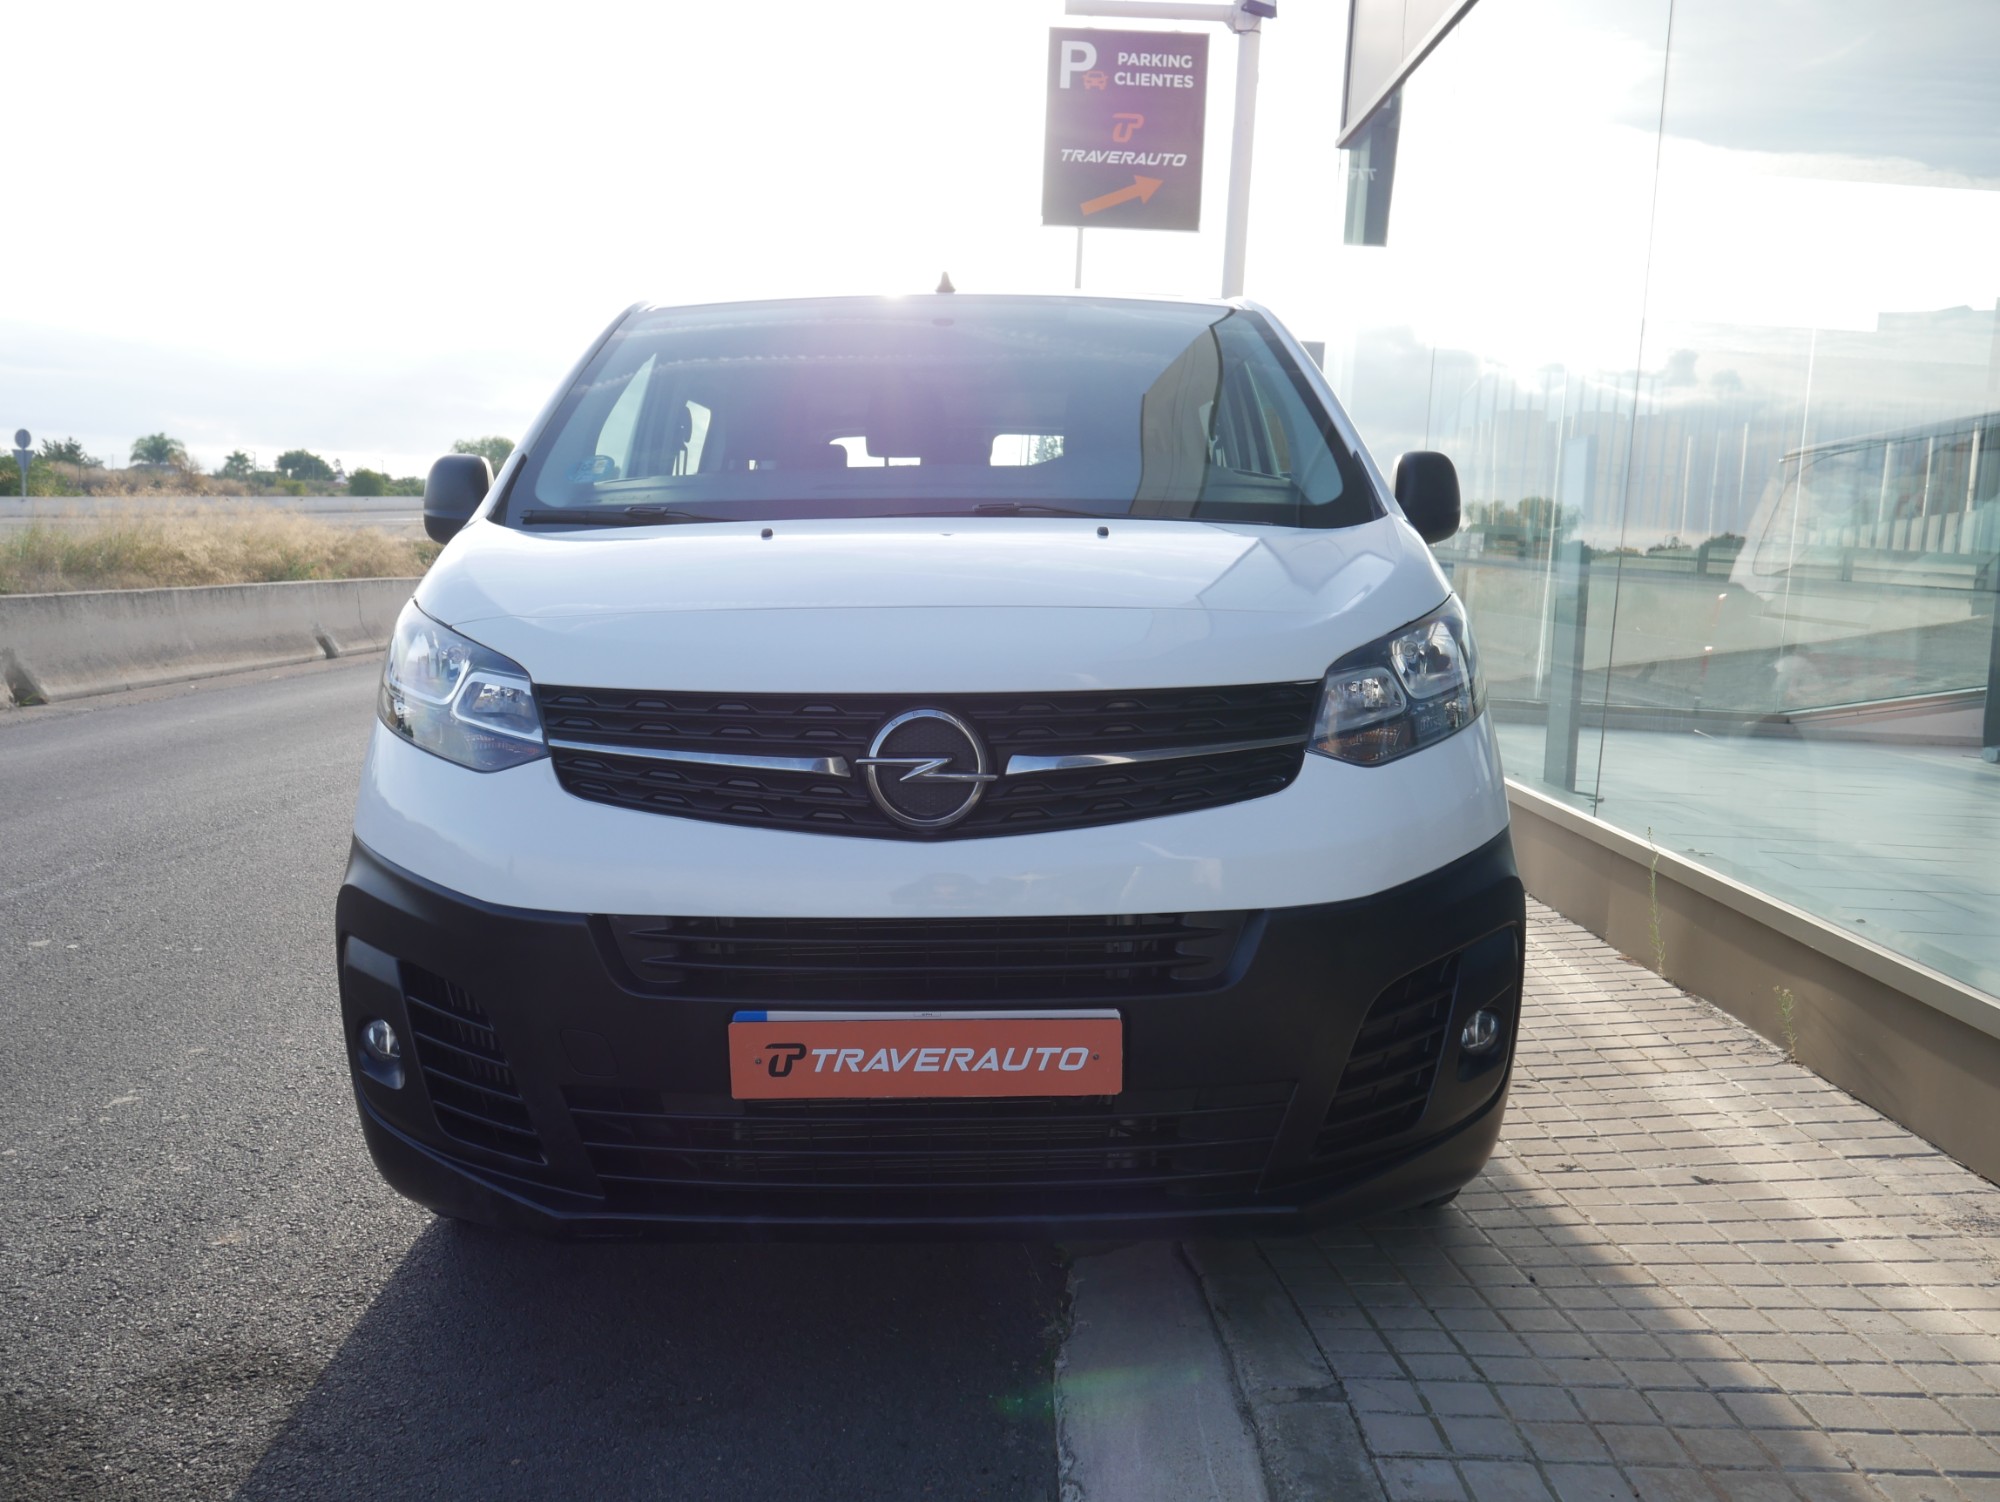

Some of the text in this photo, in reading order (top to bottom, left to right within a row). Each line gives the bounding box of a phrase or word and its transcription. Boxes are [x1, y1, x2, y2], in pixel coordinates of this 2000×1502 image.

[1059, 40, 1097, 89] P
[1117, 52, 1193, 69] PARKING
[1114, 72, 1194, 88] CLIENTES
[1061, 148, 1187, 167] TRAVERAUTO
[811, 1047, 1089, 1073] TRAVERAUTO
